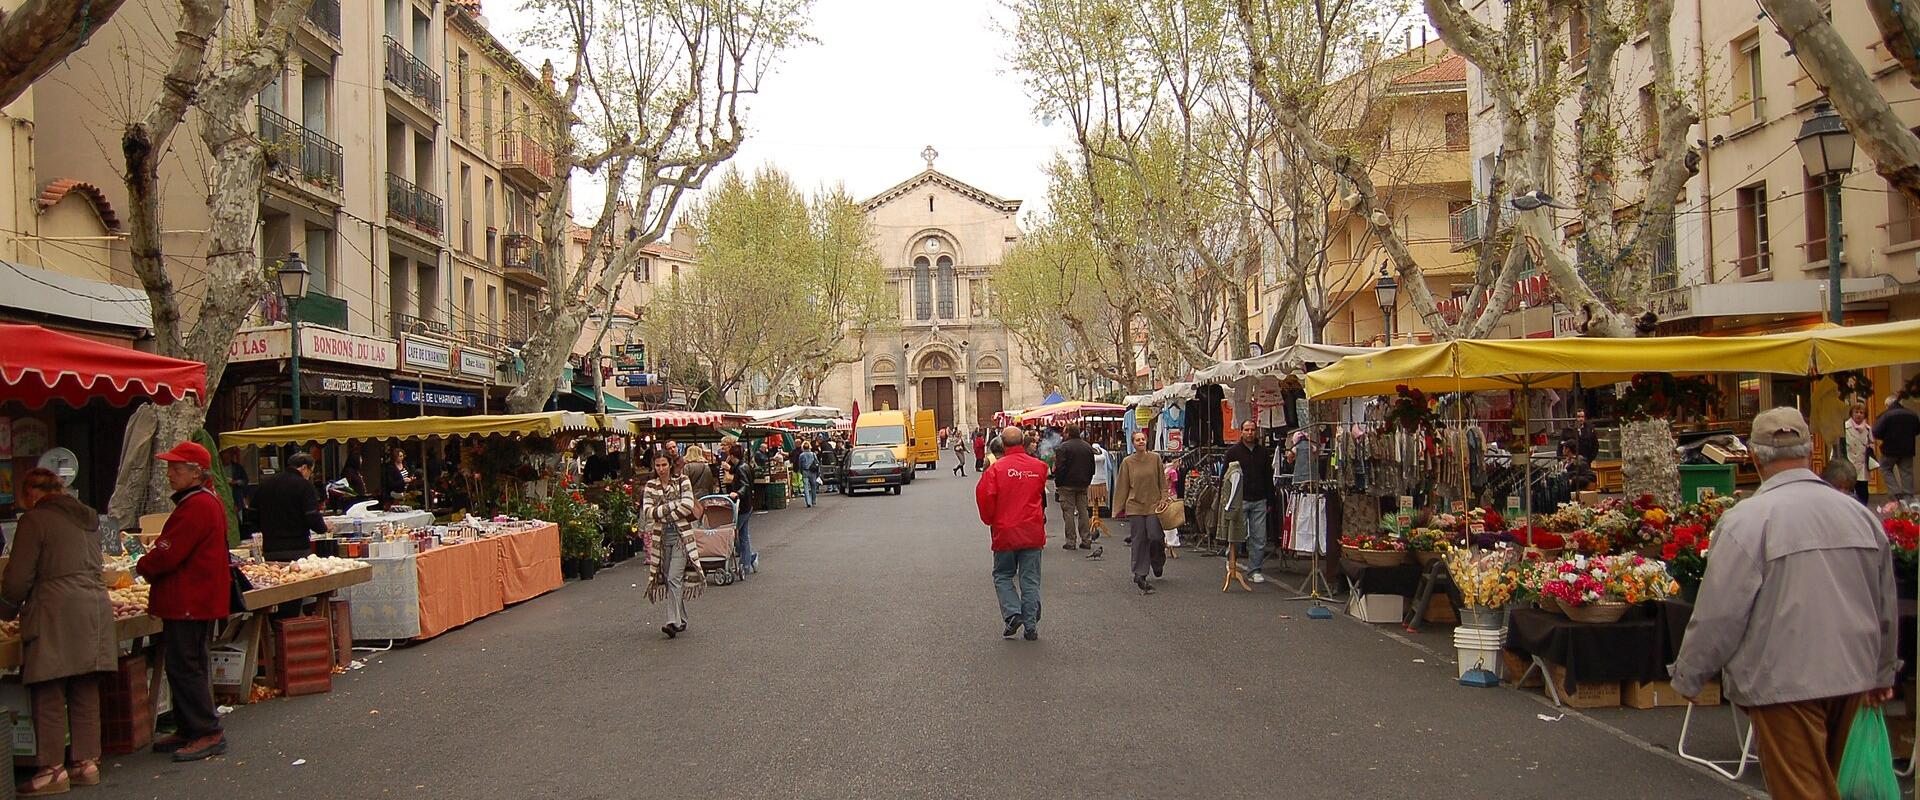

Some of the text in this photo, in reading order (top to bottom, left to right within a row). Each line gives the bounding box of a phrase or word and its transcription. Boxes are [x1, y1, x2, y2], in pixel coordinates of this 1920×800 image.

[229, 339, 267, 356] U LAS
[313, 335, 386, 362] BONBONS DU LAS
[426, 393, 434, 403] DE
